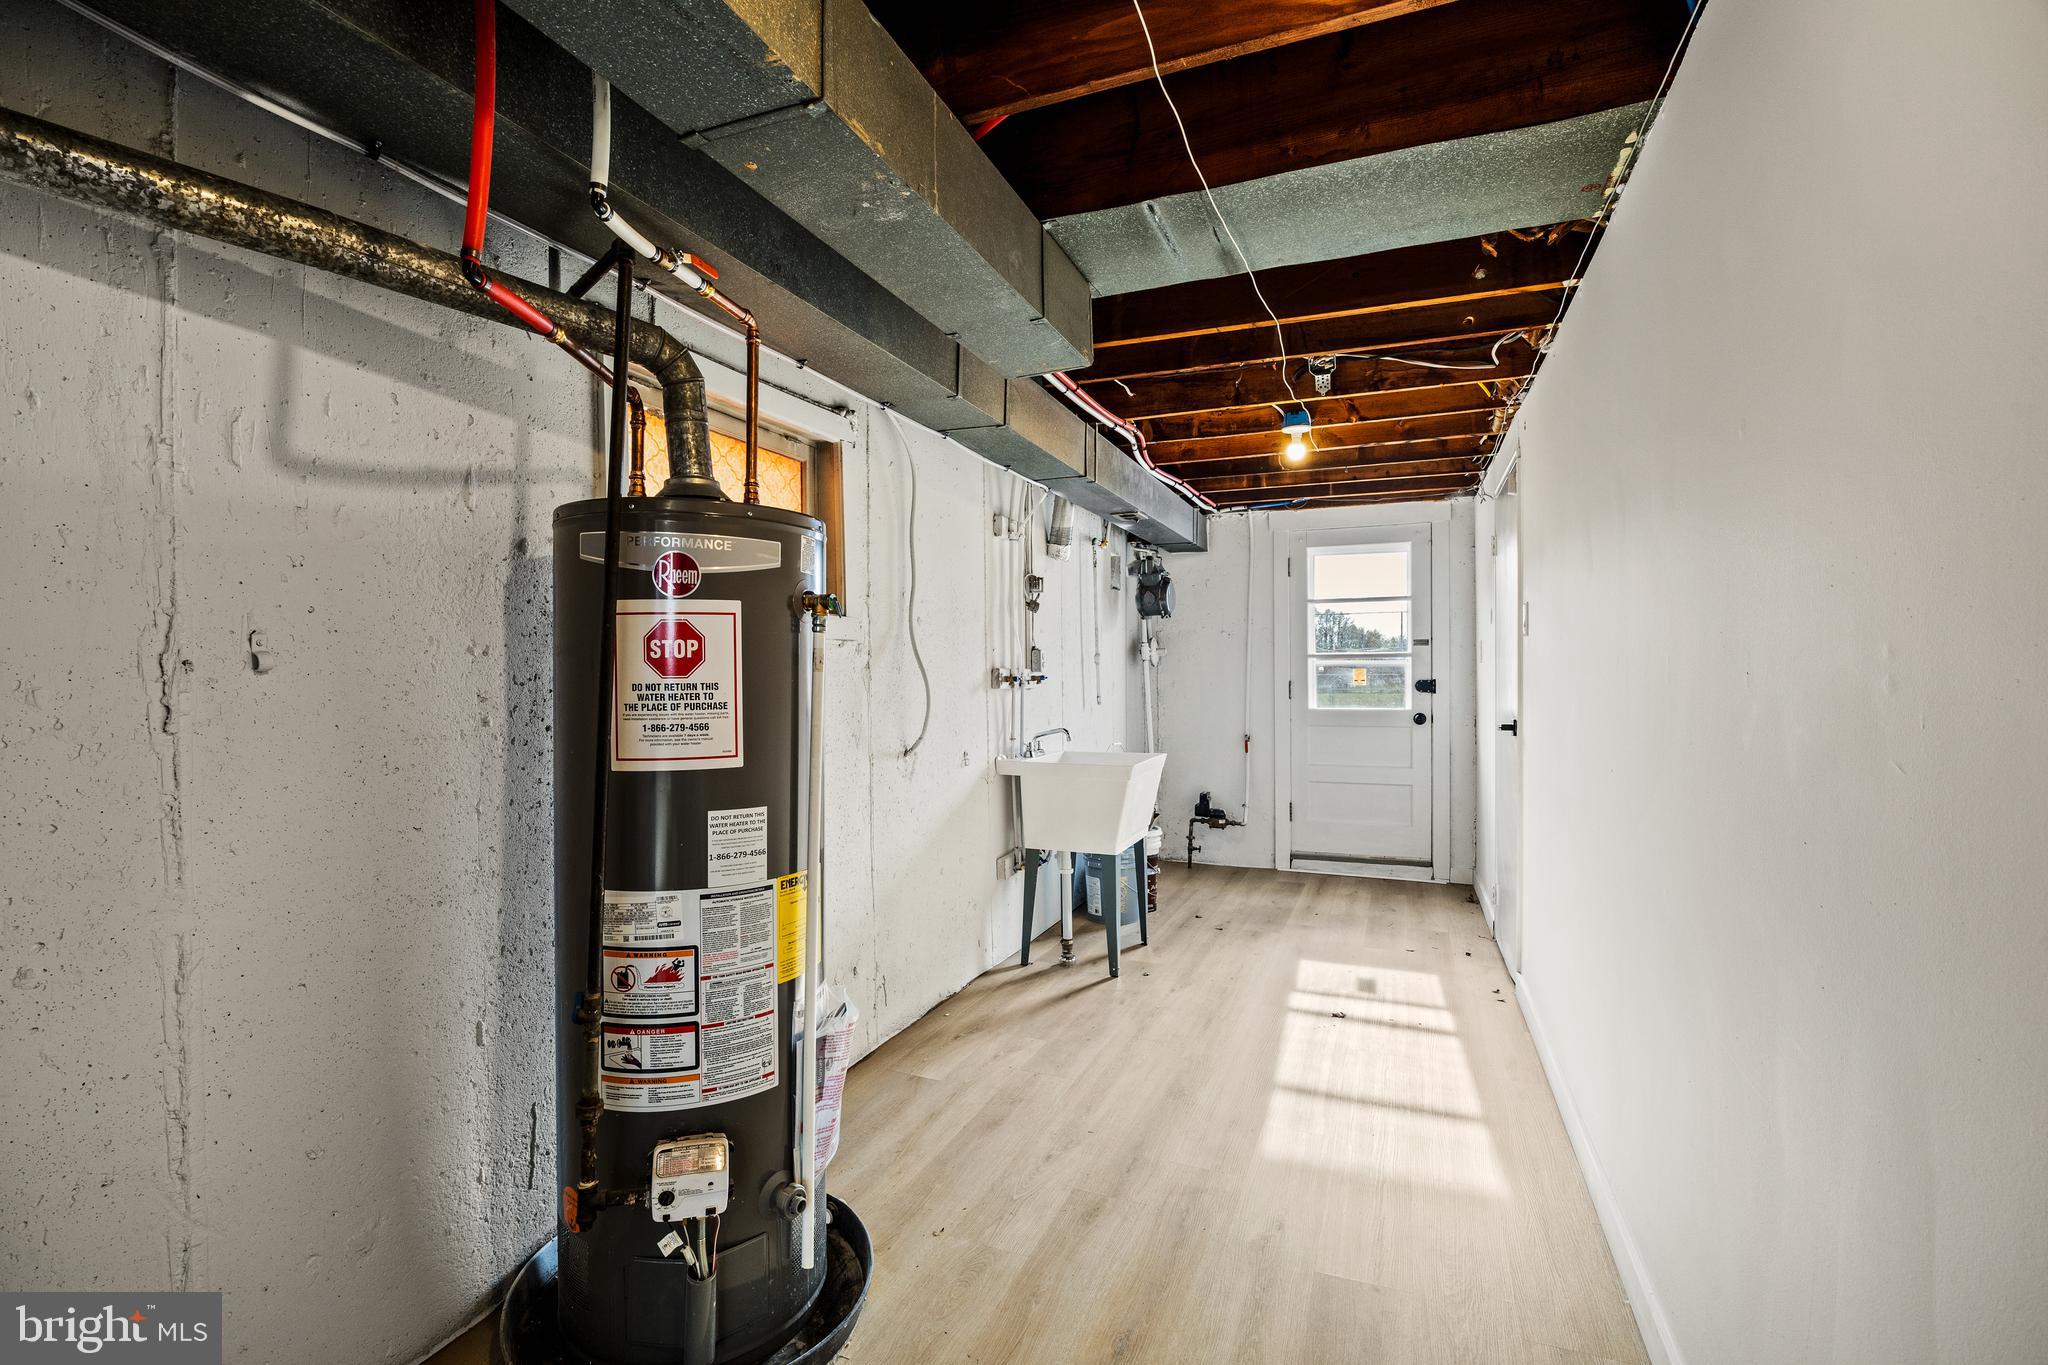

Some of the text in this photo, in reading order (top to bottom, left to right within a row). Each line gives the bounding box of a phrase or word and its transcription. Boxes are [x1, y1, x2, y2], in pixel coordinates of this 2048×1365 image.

[659, 552, 698, 589] Rheem
[650, 639, 699, 659] STOP
[632, 682, 719, 692] DO NOT RETURN THIS
[637, 693, 665, 701] WATER
[668, 693, 700, 701] HEATER
[624, 702, 728, 711] THE PLACE OF PURCHASE
[642, 723, 710, 732] 1-866-279-4566
[709, 848, 766, 861] 1-866-279-4566
